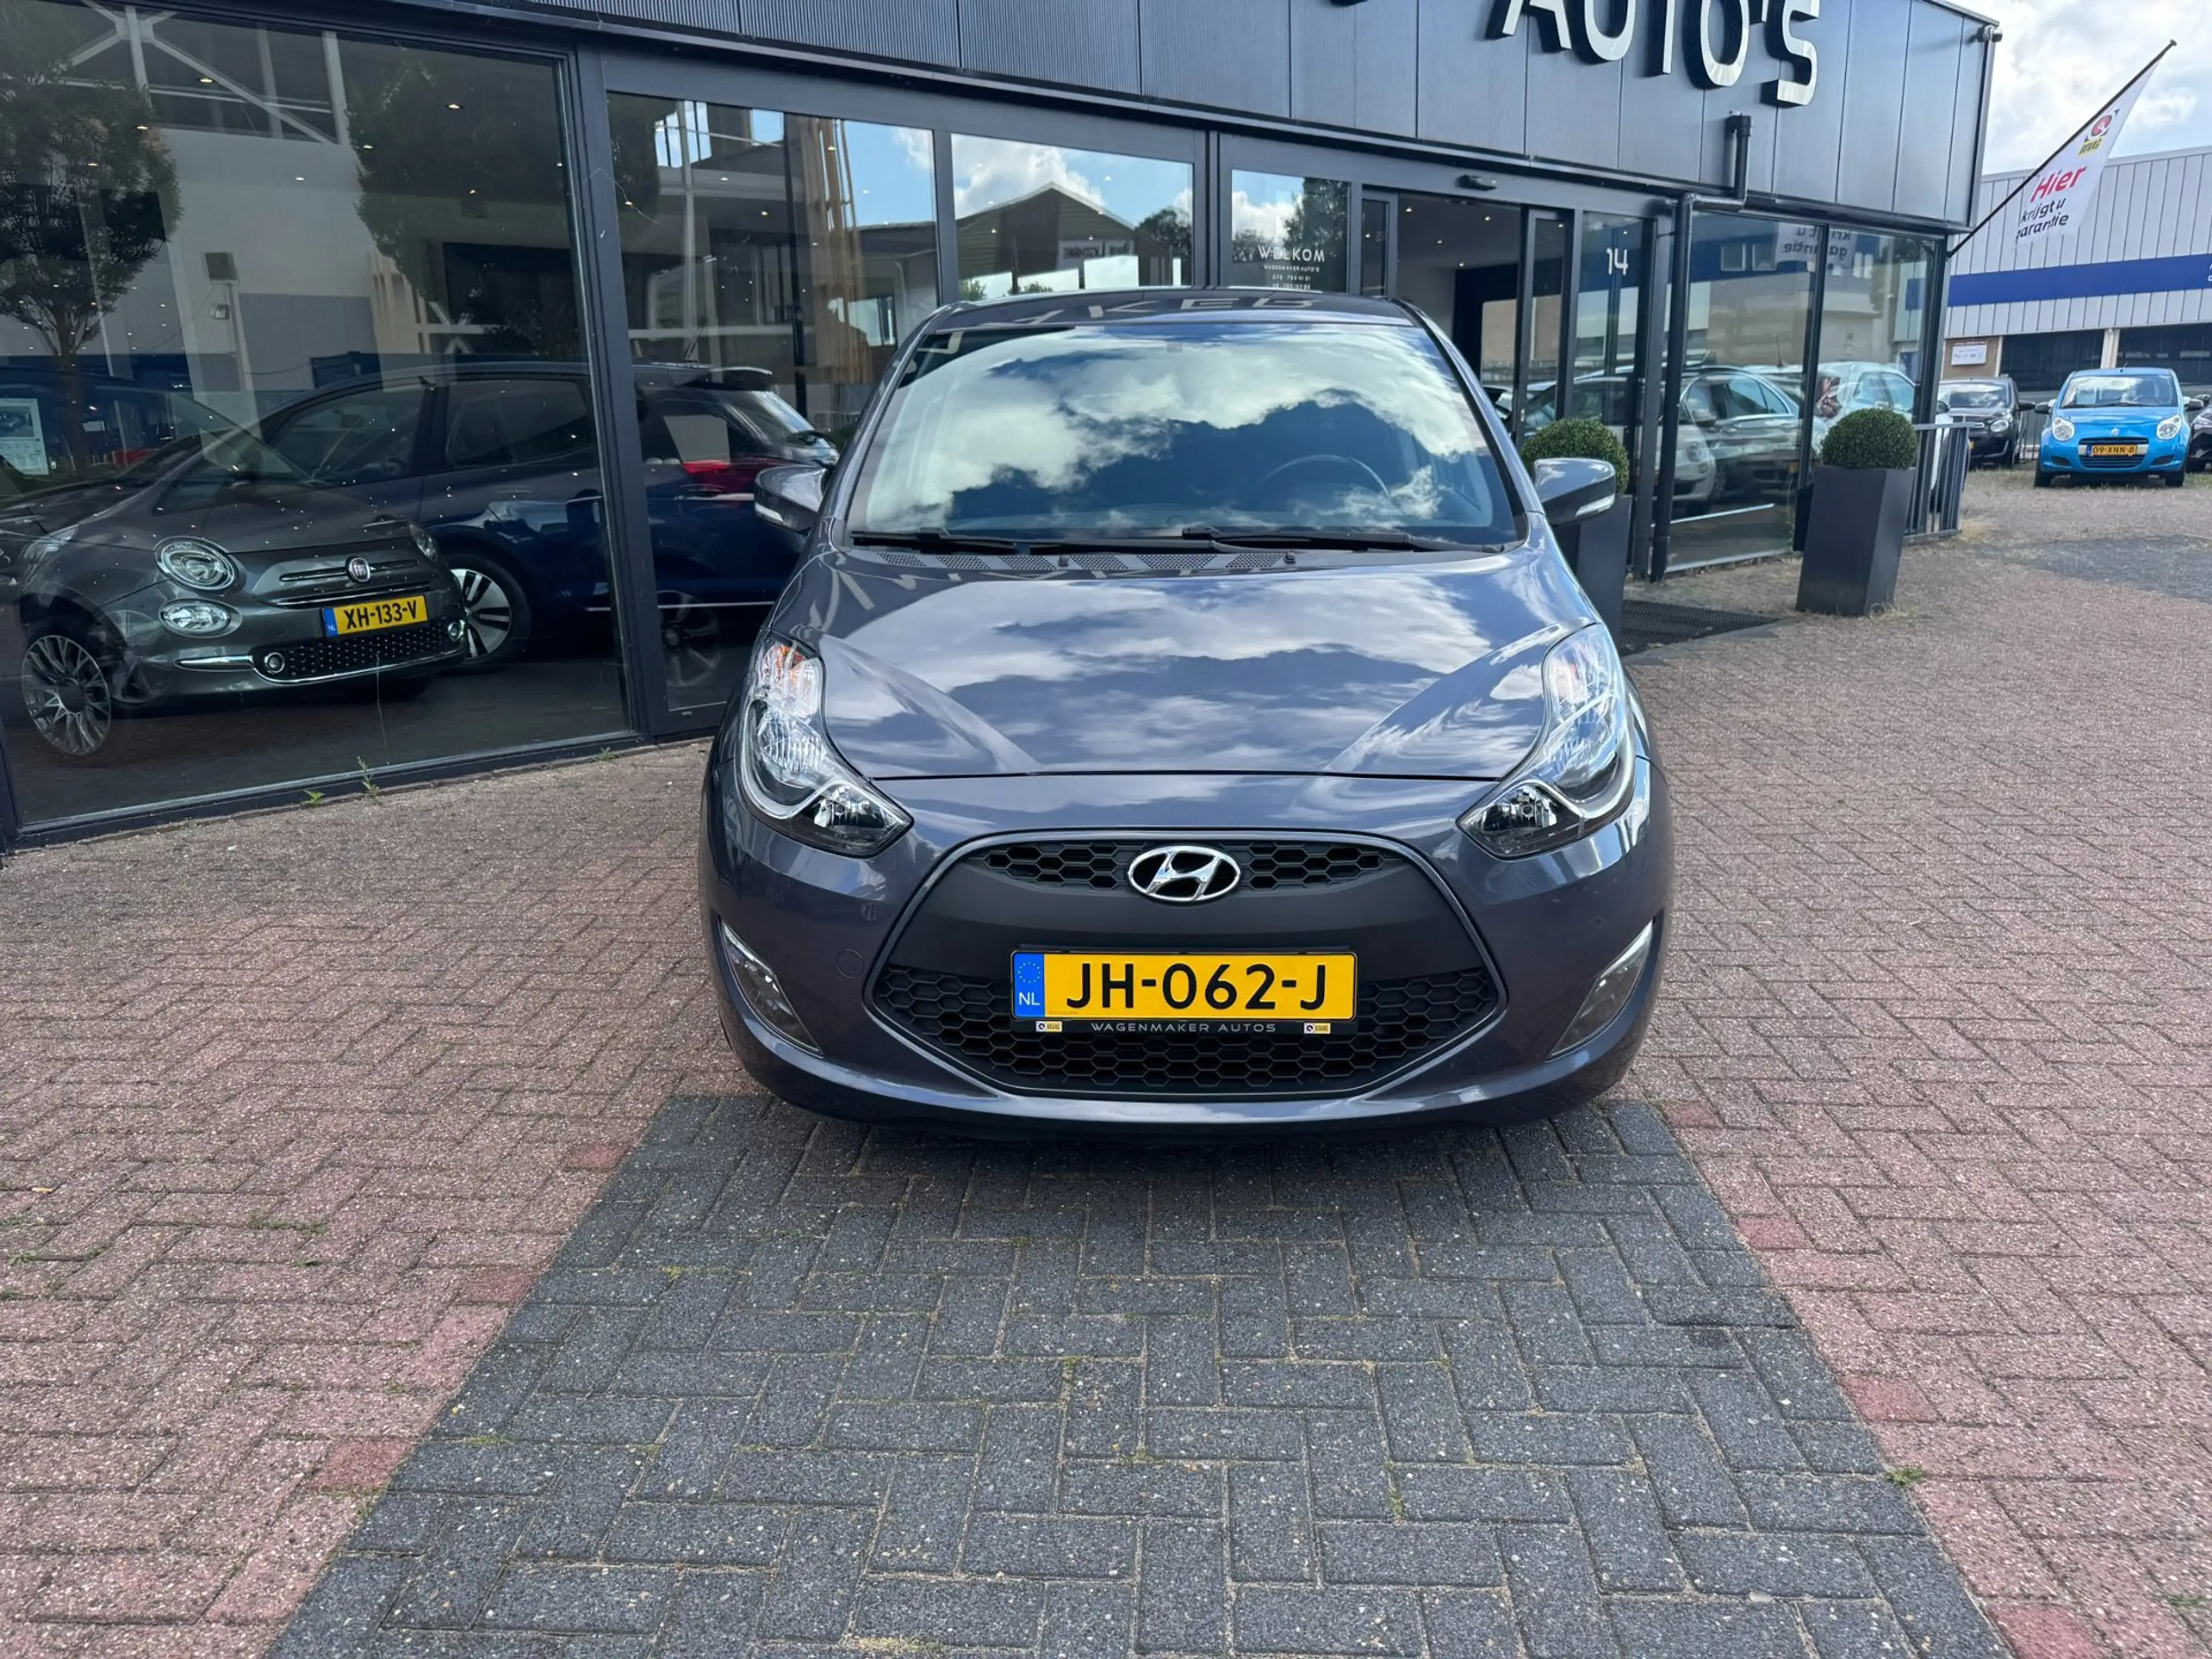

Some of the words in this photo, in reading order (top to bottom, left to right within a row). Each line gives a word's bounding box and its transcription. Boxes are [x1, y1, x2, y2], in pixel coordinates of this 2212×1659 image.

[2030, 166, 2087, 202] Hier
[2056, 198, 2066, 209] u
[1257, 244, 1325, 263] WLKOM
[1606, 248, 1628, 275] 14
[343, 600, 417, 630] XH-133-V
[1018, 992, 1040, 1006] NL
[1066, 963, 1327, 1010] JH-062-J
[1090, 1022, 1210, 1032] WAGENMAKER
[1218, 1023, 1277, 1033] AUTOS
